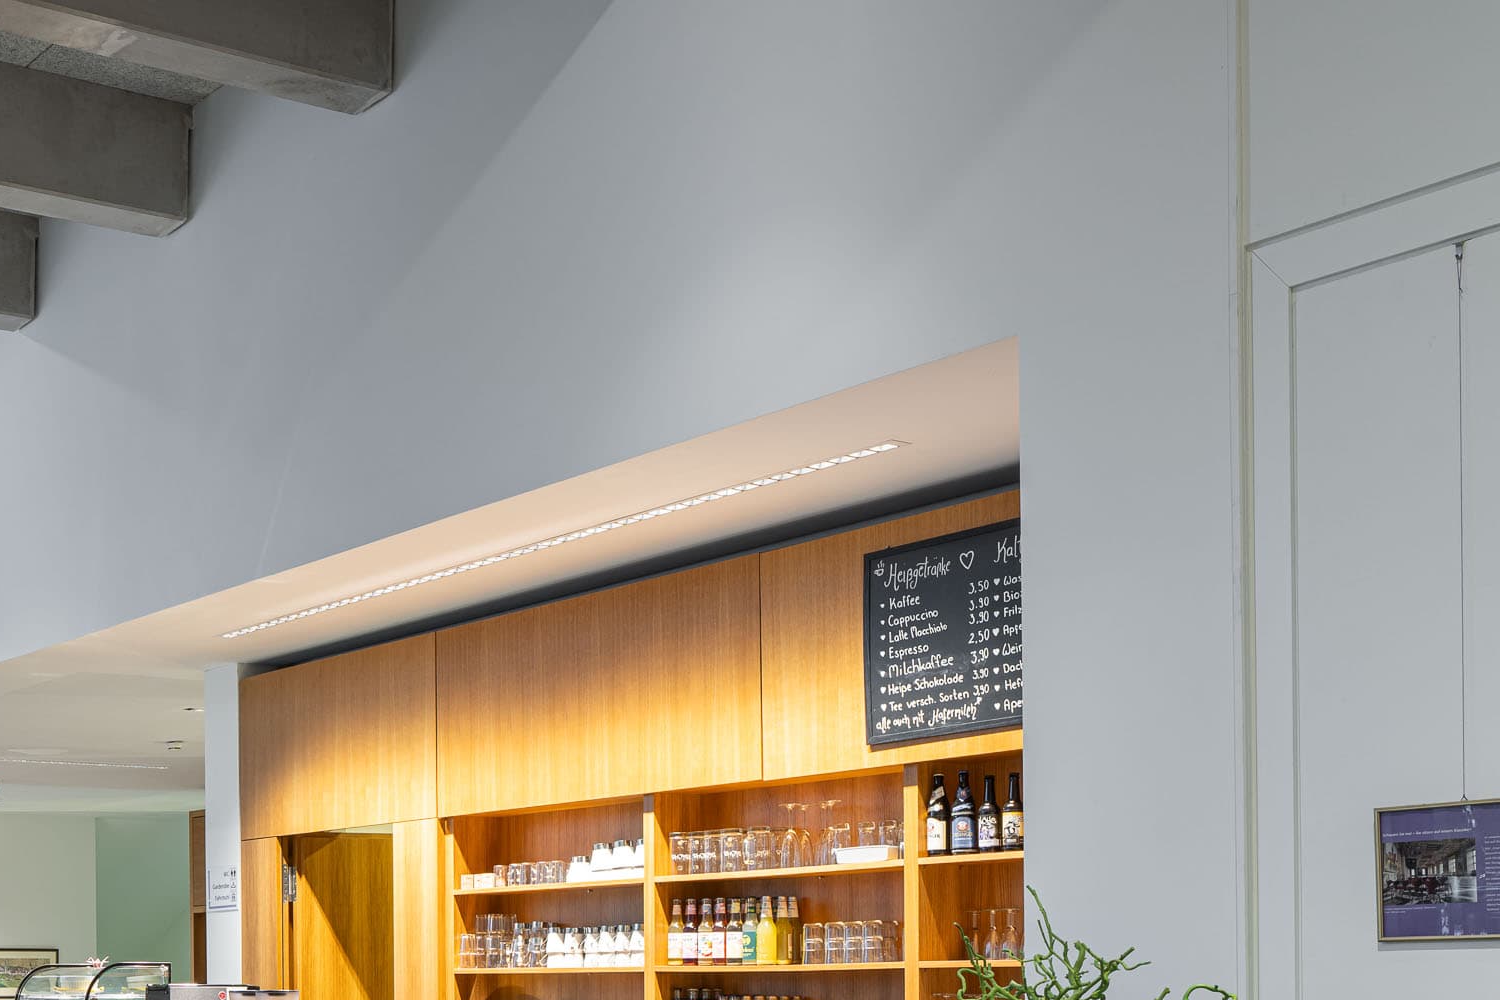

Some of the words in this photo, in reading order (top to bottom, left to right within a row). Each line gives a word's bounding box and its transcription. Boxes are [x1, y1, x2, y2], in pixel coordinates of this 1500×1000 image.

[889, 595, 921, 610] Kaffee
[888, 609, 939, 627] Cappuccino
[910, 621, 948, 638] Macchiato
[888, 644, 930, 660] Espresso
[888, 654, 954, 678] Milchkaffee
[914, 673, 964, 691] Schokolade
[889, 701, 903, 713] Tee
[906, 694, 937, 709] versch.
[939, 688, 970, 703] Sorten
